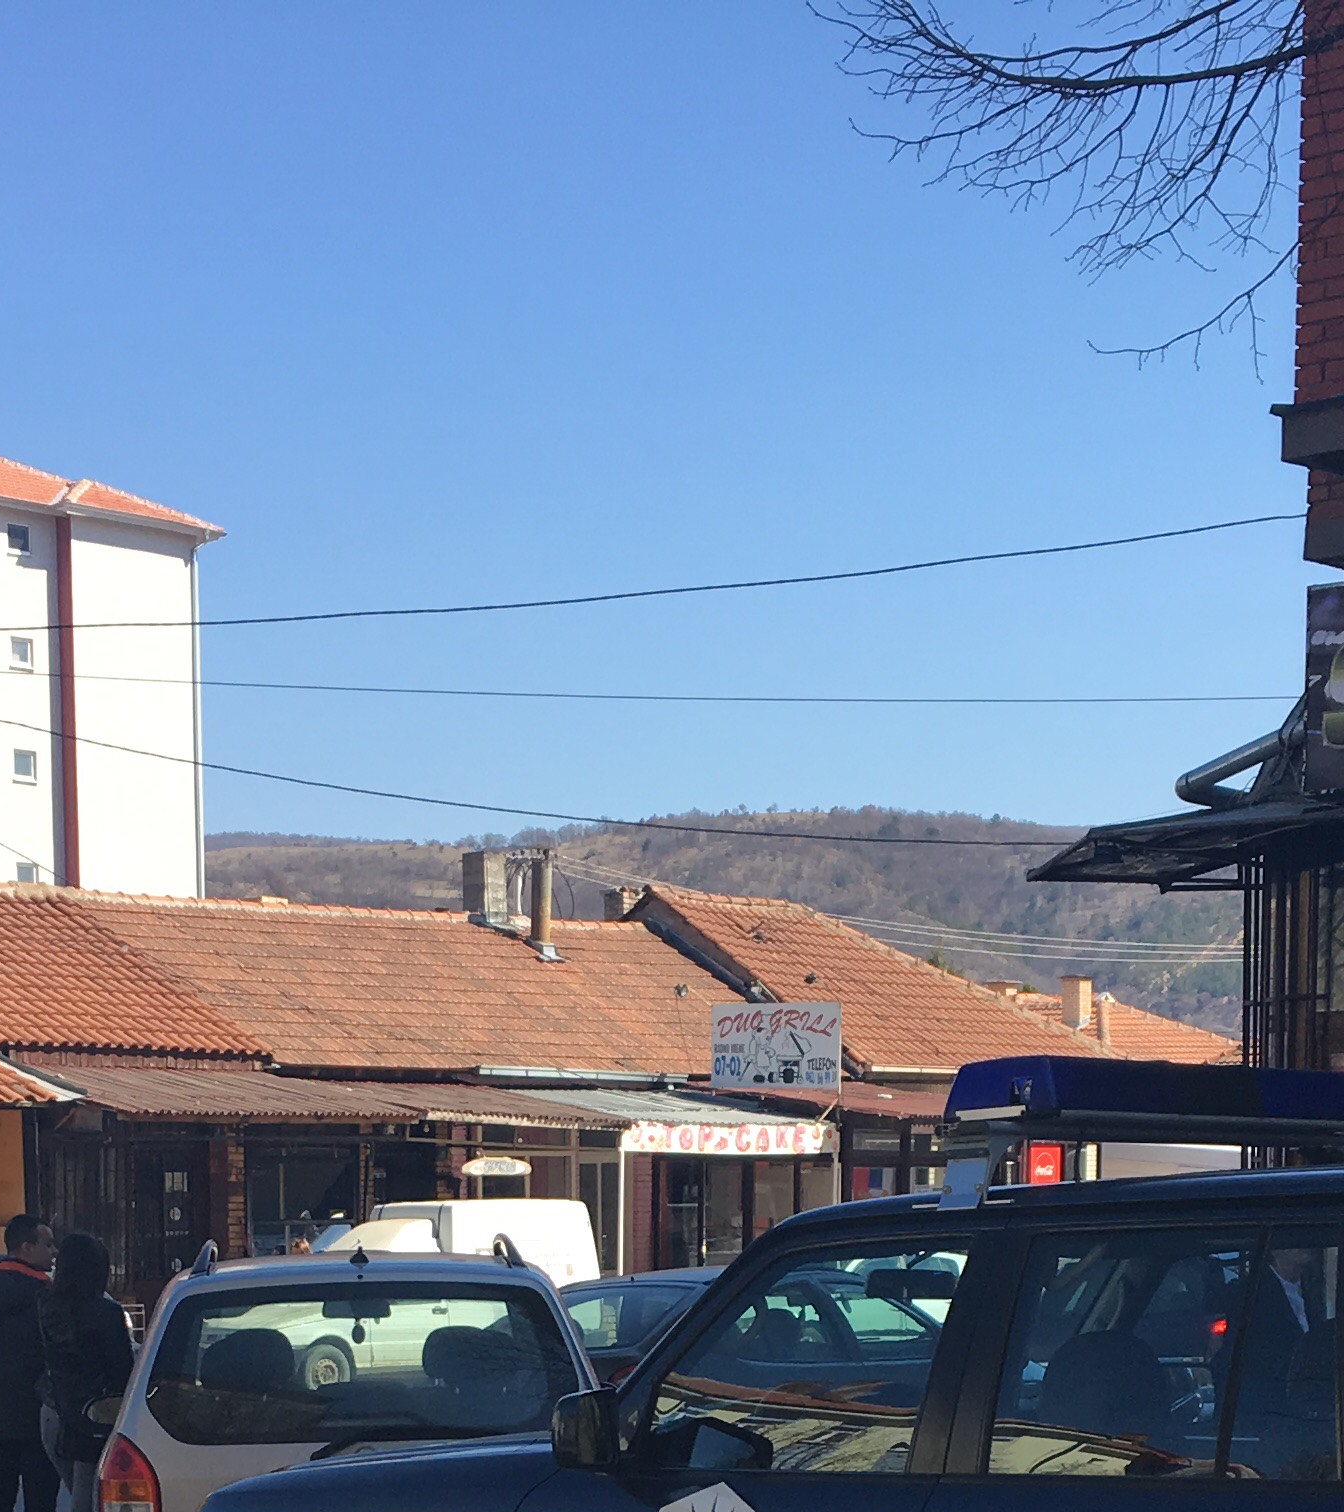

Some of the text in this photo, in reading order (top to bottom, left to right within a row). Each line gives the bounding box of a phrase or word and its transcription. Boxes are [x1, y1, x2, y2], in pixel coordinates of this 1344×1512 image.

[717, 1008, 838, 1039] DUO GRILL
[807, 1057, 837, 1072] TELEFON
[663, 1123, 808, 1154] TOP CAKE
